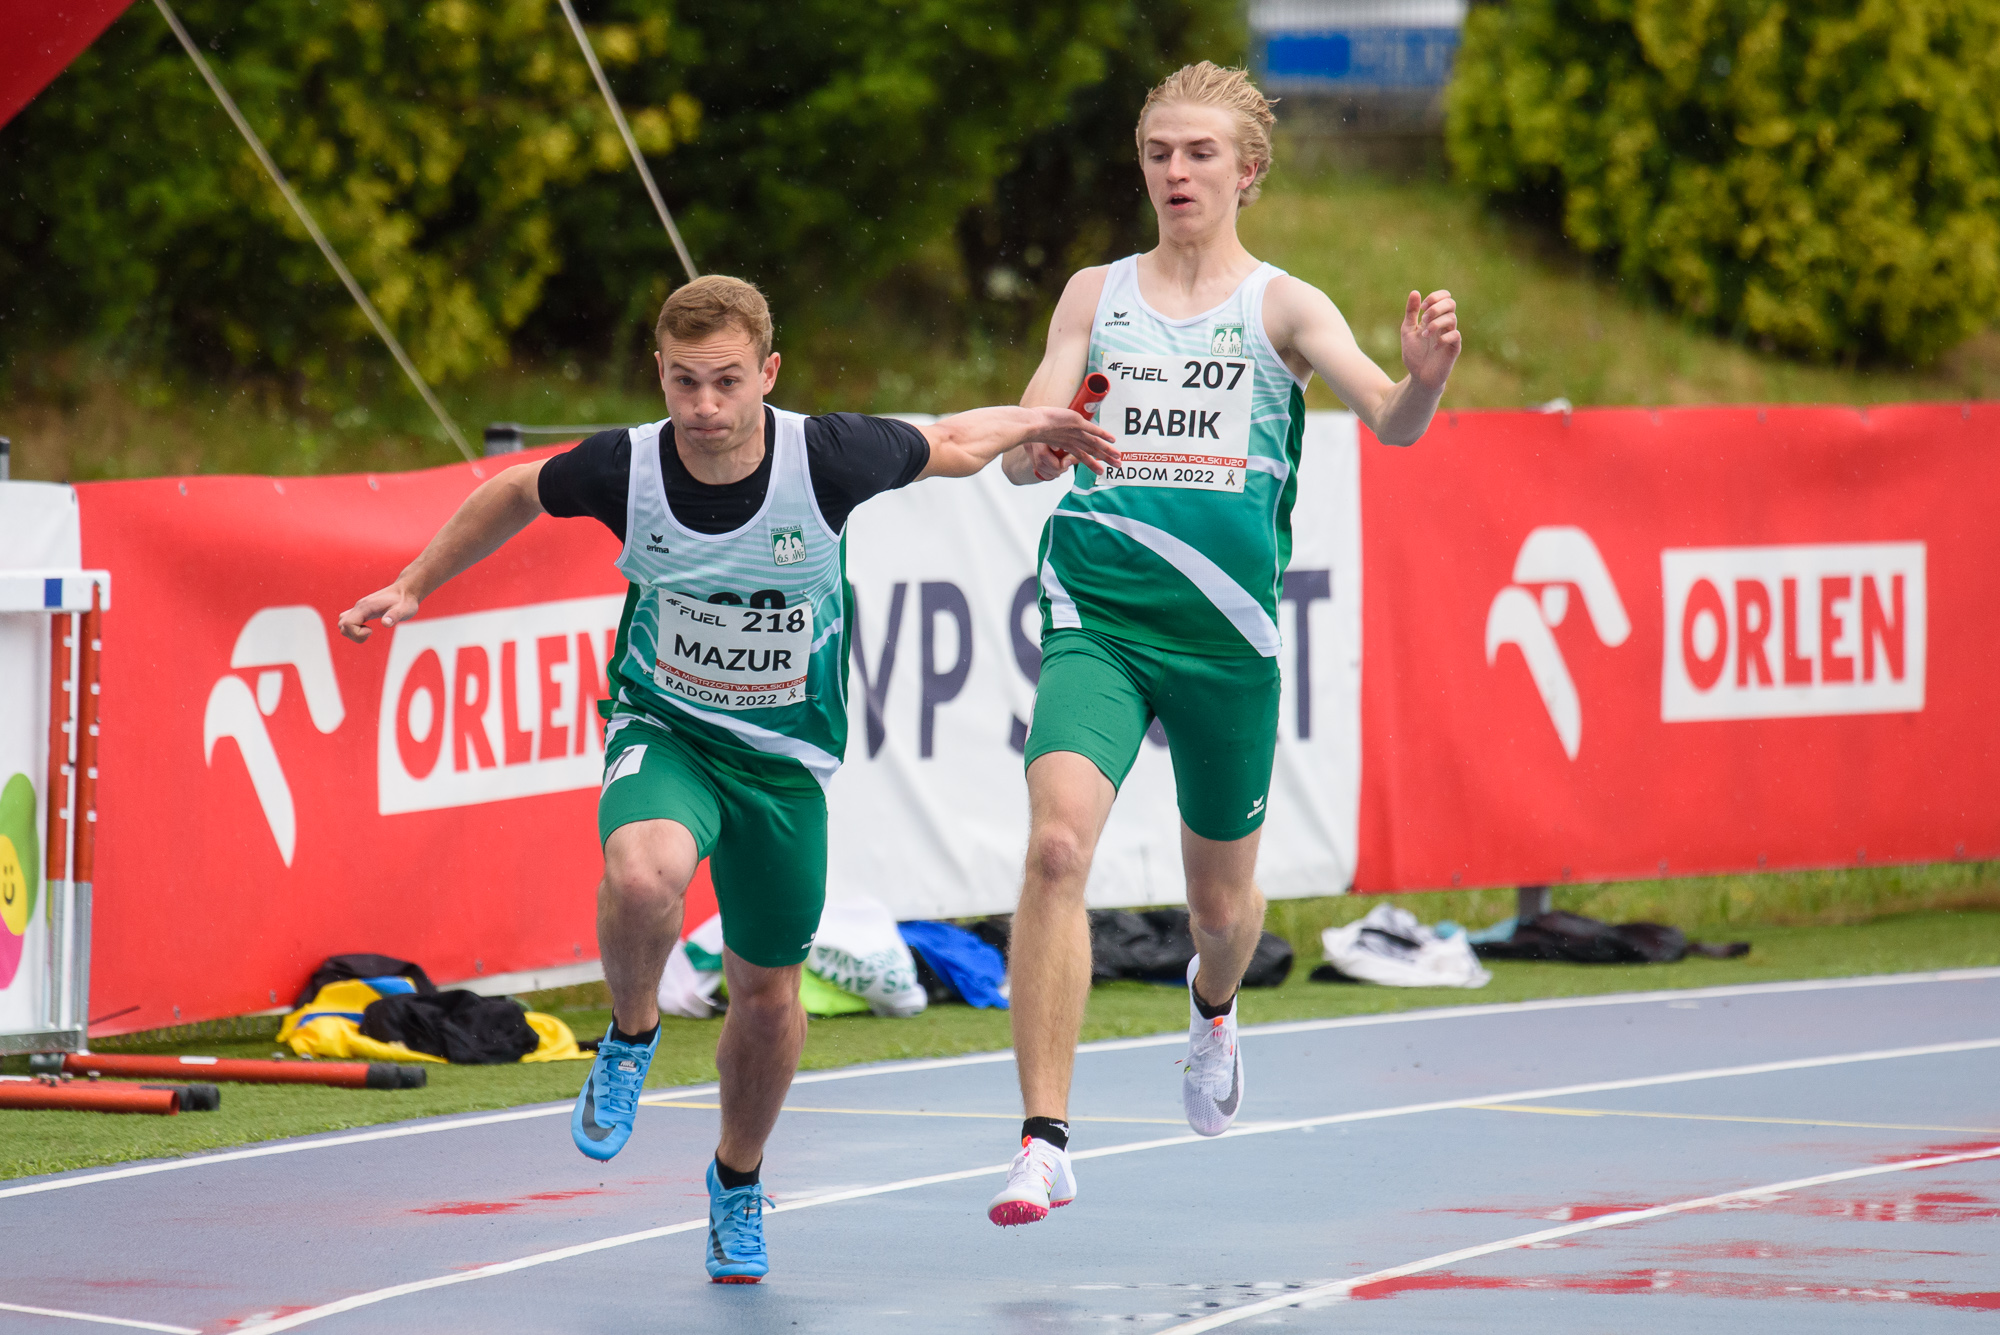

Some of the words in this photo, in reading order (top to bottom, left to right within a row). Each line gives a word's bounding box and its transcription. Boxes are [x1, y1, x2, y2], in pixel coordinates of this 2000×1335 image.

[1121, 367, 1168, 382] FUEL
[1181, 360, 1246, 391] 207
[1124, 407, 1221, 439] BABIK
[1106, 466, 1168, 481] RADOM
[1173, 468, 1214, 483] 2022
[1122, 453, 1187, 463] MISTRZOSTWA
[1188, 455, 1222, 465] POLSKI
[1224, 459, 1244, 467] U20
[646, 544, 669, 553] erima
[680, 605, 727, 627] FUEL
[741, 608, 806, 633] 218
[1681, 573, 1905, 694] ORLEN
[673, 633, 792, 672] MAZUR
[659, 661, 681, 676] PZLA
[681, 672, 750, 691] MISTRZOSTWA
[751, 683, 785, 692] POLSKI
[786, 677, 805, 688] U20
[850, 581, 973, 758] VP
[396, 629, 617, 781] ORLEN
[665, 676, 729, 705] RADOM
[735, 694, 777, 707] 2022
